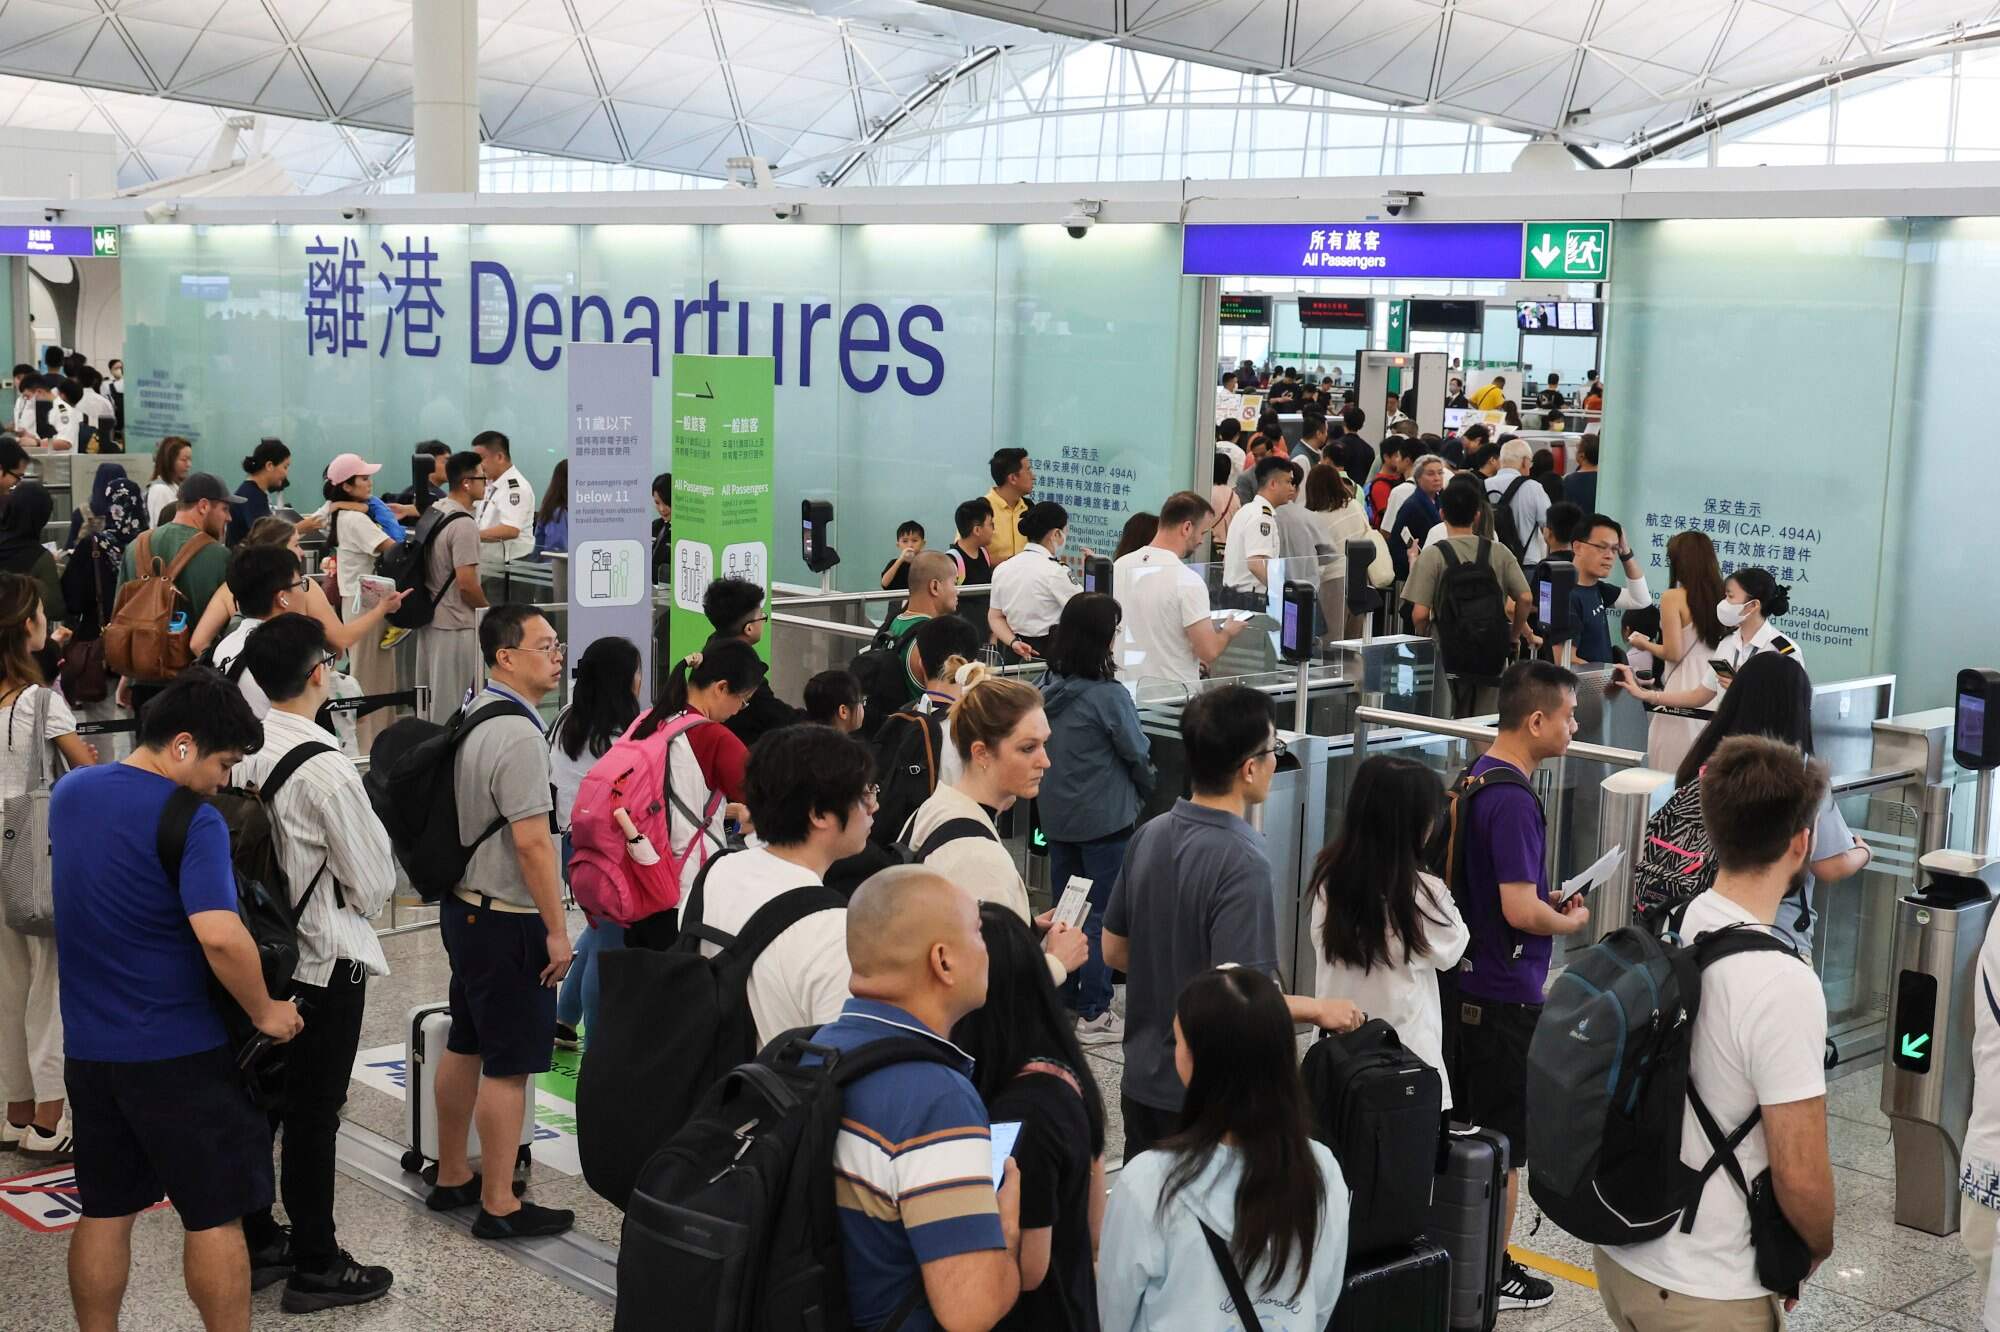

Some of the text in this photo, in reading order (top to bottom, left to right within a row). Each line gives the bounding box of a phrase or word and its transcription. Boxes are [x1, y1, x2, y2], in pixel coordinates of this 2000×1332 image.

[1309, 230, 1381, 251] 所有旅客
[1302, 252, 1386, 270] All Passengers
[304, 235, 446, 359] 離港
[1062, 445, 1099, 461] 保安告示
[1109, 468, 1136, 481] 494A)
[675, 480, 683, 490] All
[722, 484, 768, 496] All Passengers
[576, 490, 628, 503] below 11
[1704, 499, 1761, 518] 保安告示
[1069, 524, 1105, 537] Regulation
[1645, 513, 1731, 534] 航空保安規例
[1779, 527, 1822, 545] 494A)
[1078, 536, 1093, 545] with
[1094, 538, 1110, 546] valid
[1780, 616, 1810, 629] travel
[1813, 621, 1870, 637] document
[1801, 631, 1822, 643] this
[1824, 634, 1853, 647] point
